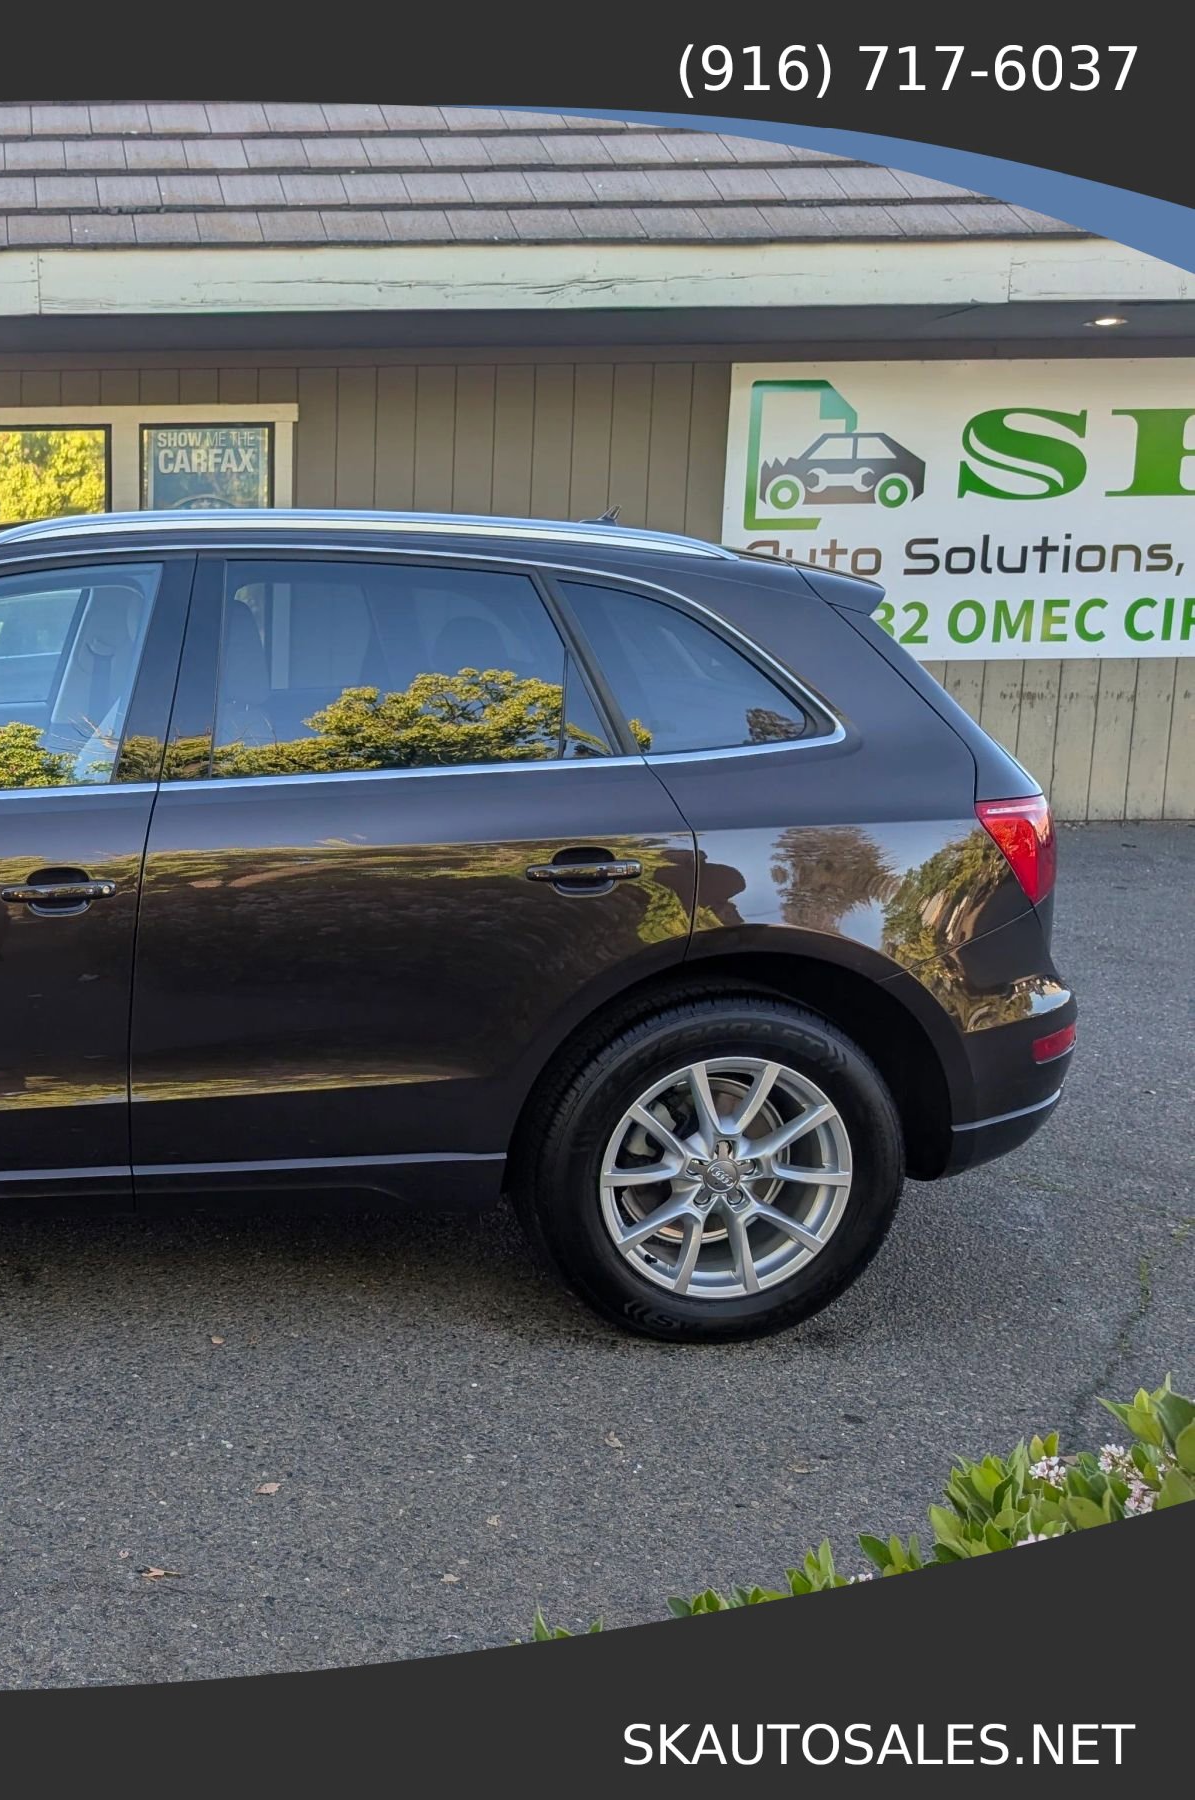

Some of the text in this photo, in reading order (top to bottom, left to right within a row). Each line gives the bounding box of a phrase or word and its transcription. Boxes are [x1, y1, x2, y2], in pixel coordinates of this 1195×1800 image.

[157, 431, 255, 448] SHOW ME THE
[158, 448, 254, 474] CARFAX
[903, 533, 1184, 577] Solutions,
[947, 598, 1108, 644] OMEC
